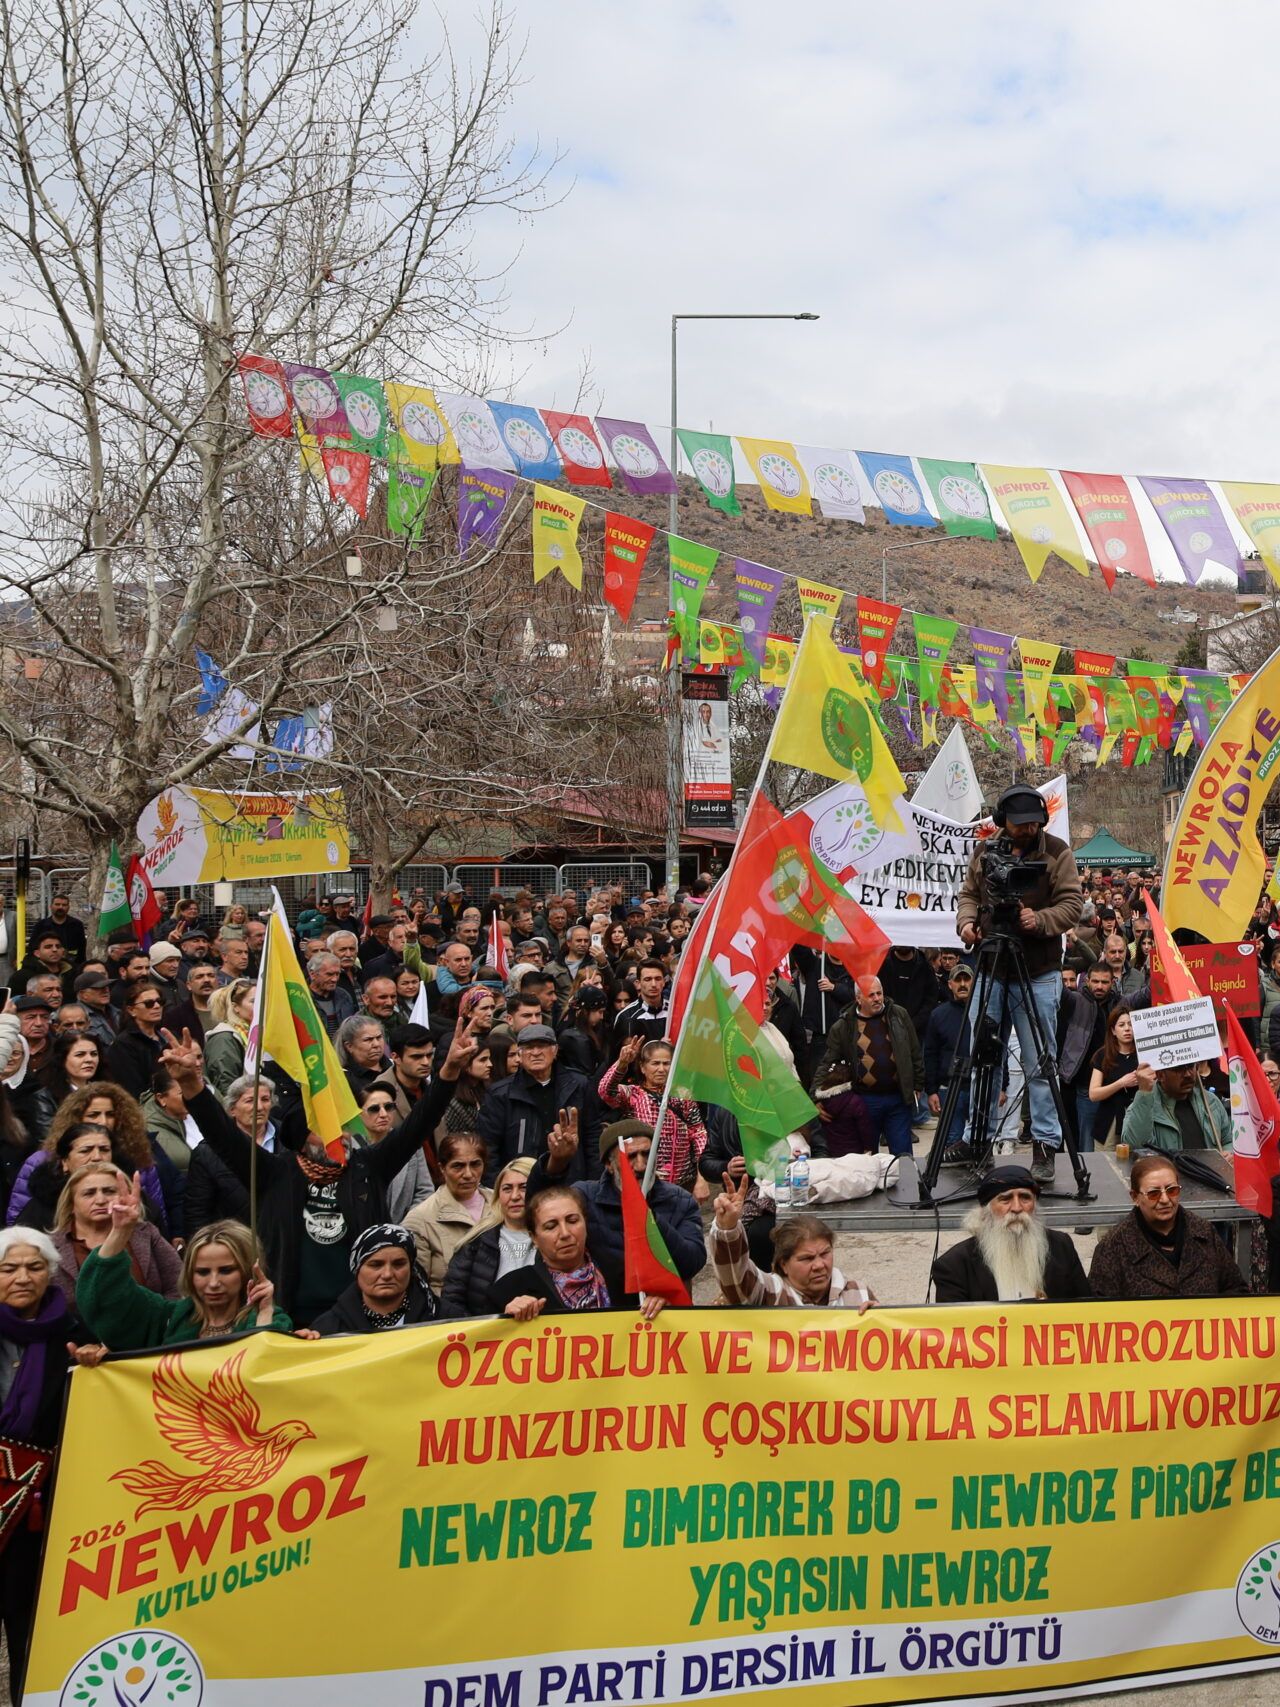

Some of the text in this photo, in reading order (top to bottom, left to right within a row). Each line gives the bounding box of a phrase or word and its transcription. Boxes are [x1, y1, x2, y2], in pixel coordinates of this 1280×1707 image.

[994, 482, 1050, 496] NEWROZ
[1075, 494, 1128, 507] NEWROZ
[1151, 493, 1209, 506] NEWROZ
[535, 500, 576, 521] NEWROZ
[736, 575, 774, 592] NEWROZ
[800, 588, 837, 603] NEWROZ
[858, 610, 894, 626] NEWROZ
[1079, 662, 1111, 675] NEWROZ
[1173, 742, 1243, 886] NEWROZA
[144, 825, 185, 872] NEWROZ
[860, 884, 890, 908] EY
[436, 1316, 1277, 1388] ÖZGÜRLÜK VE DEMOKRASİ NEWROZUNU
[417, 1403, 687, 1468] MUNZURUN
[702, 1397, 974, 1459] ÇOŞKUSUYLA
[399, 1490, 596, 1569] NEWROZ
[623, 1479, 834, 1548] BIMBAREK
[847, 1478, 900, 1535] BO
[951, 1467, 1120, 1531] NEWROZ
[58, 1456, 368, 1616] NEWROZ
[68, 1520, 127, 1554] 2026
[135, 1537, 311, 1626] KUTLU OLSUN!
[688, 1545, 1052, 1632] YAŞASIN NEWROZ
[1256, 1625, 1278, 1640] DEM
[424, 1616, 1062, 1707] DEM PARTİ DERSİM İL ÖRGÜTÜ
